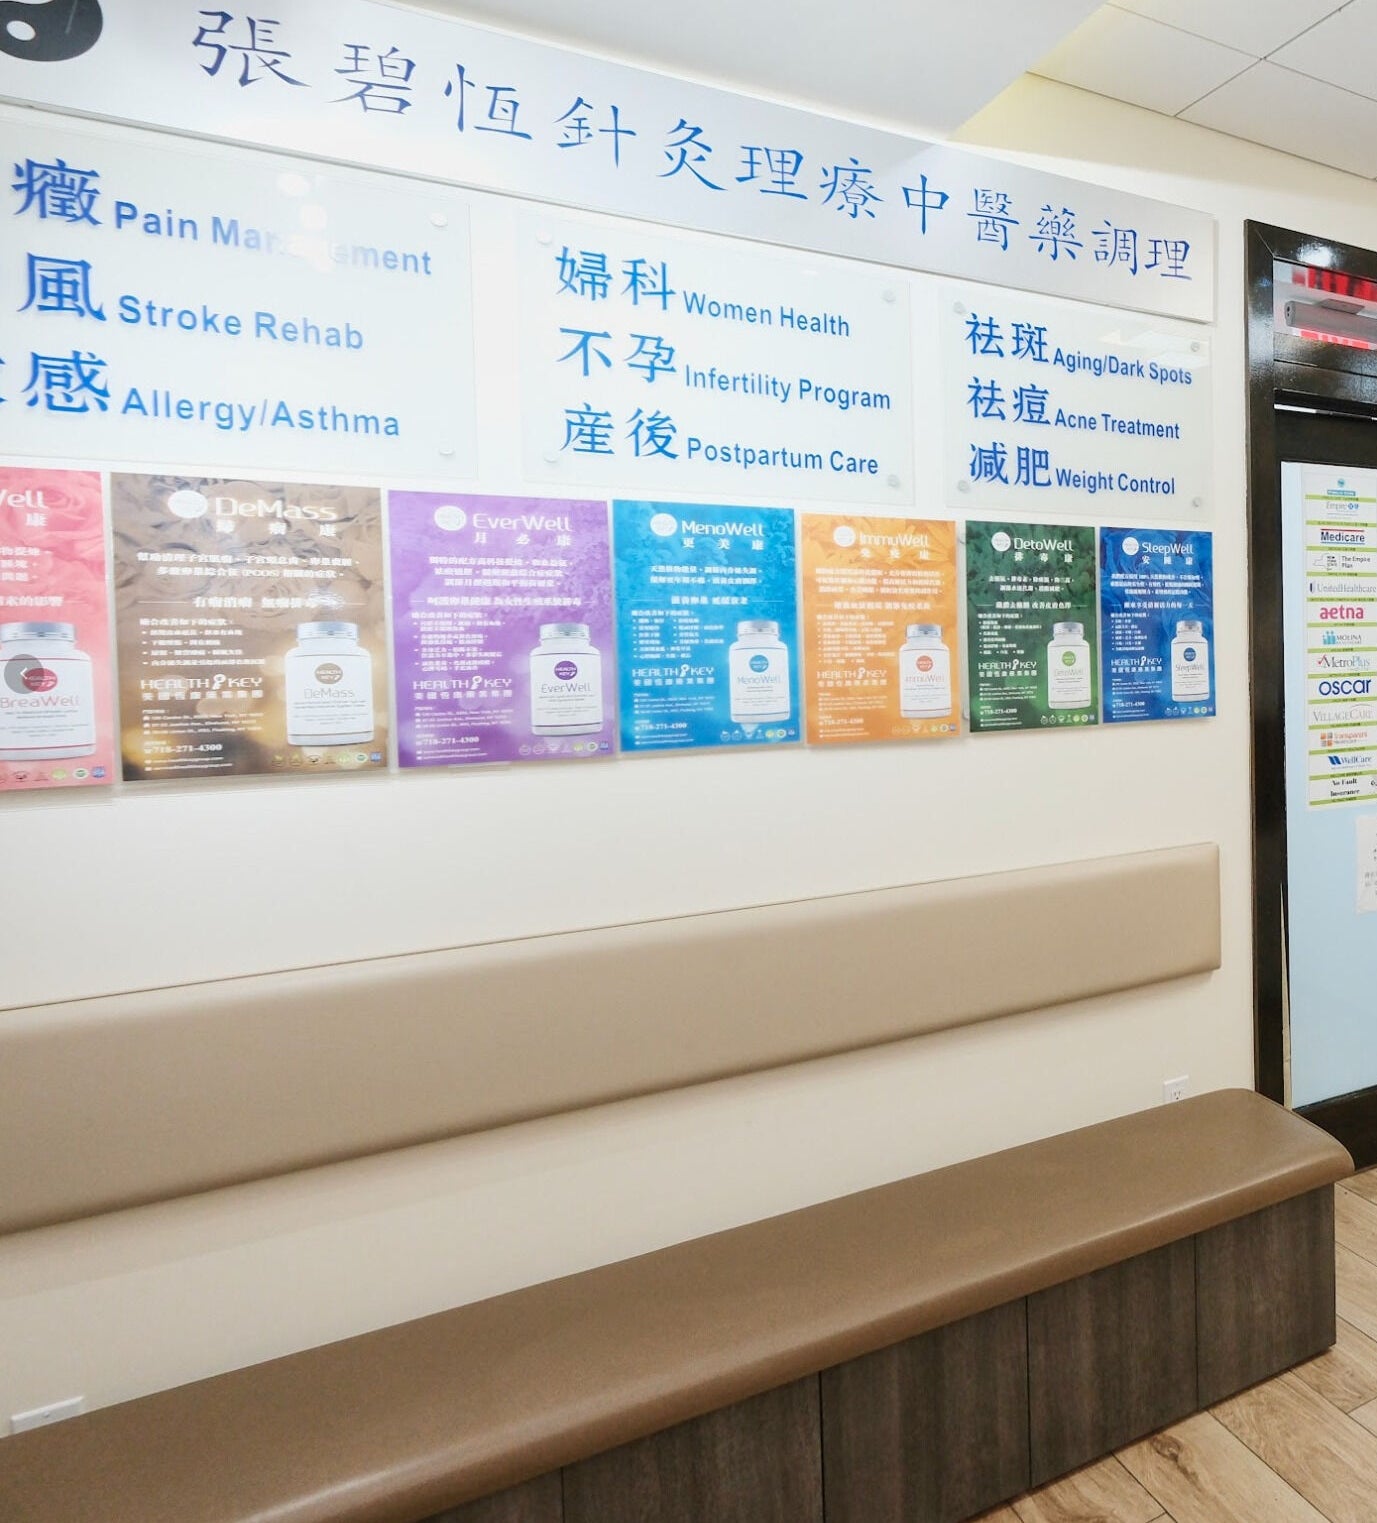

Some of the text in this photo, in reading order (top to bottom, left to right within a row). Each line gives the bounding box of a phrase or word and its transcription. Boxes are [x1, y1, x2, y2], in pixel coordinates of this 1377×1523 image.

[115, 200, 198, 240] Pain
[555, 246, 850, 337] 婦科 Women Health
[17, 252, 364, 350] 風 Stroke Rehab
[965, 312, 1192, 385] 祛斑 Aging/Dark Spots
[556, 327, 891, 410] 不孕 Infertility Program
[121, 387, 400, 437] Allergy/Asthma
[966, 375, 1180, 440] 祛痘 Acne Treatment
[687, 436, 823, 470] Postpartum
[829, 449, 879, 475] Care
[1055, 467, 1113, 494] Weight
[1117, 472, 1176, 495] Control
[216, 497, 338, 520] DeMass
[473, 512, 573, 532] EverWell
[681, 519, 765, 537] MenoWell
[860, 532, 929, 547] ImmuWell
[1014, 537, 1074, 551] DetoWell
[1320, 531, 1365, 542] Medicare
[1141, 541, 1194, 556] SleepWell
[1320, 604, 1364, 620] aetna
[632, 666, 715, 677] HEALTH KEY
[978, 661, 1037, 670] HEALTH KEY
[141, 677, 263, 690] HEALTH KEY
[413, 678, 512, 690] HEALTH KEY
[817, 671, 856, 679] HEALTH
[1319, 679, 1372, 696] oscar
